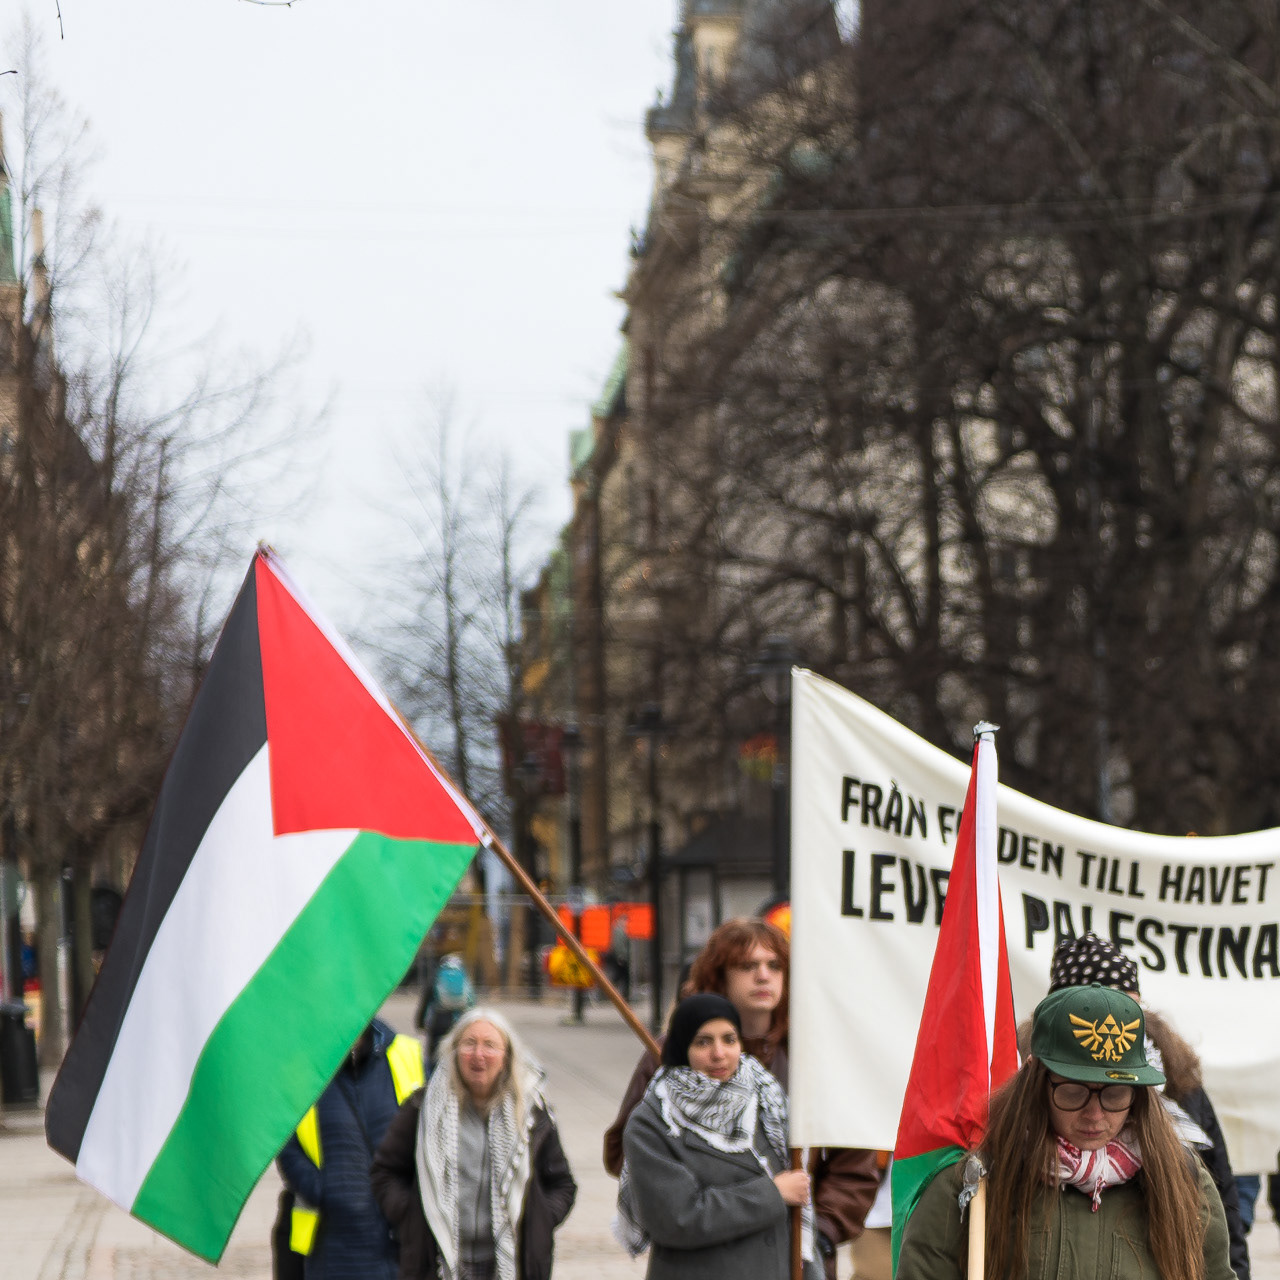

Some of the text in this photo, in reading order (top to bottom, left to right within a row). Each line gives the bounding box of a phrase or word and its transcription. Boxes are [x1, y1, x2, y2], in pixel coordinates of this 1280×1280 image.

[841, 776, 1275, 905] FRÅN FDEN TILL HAVET
